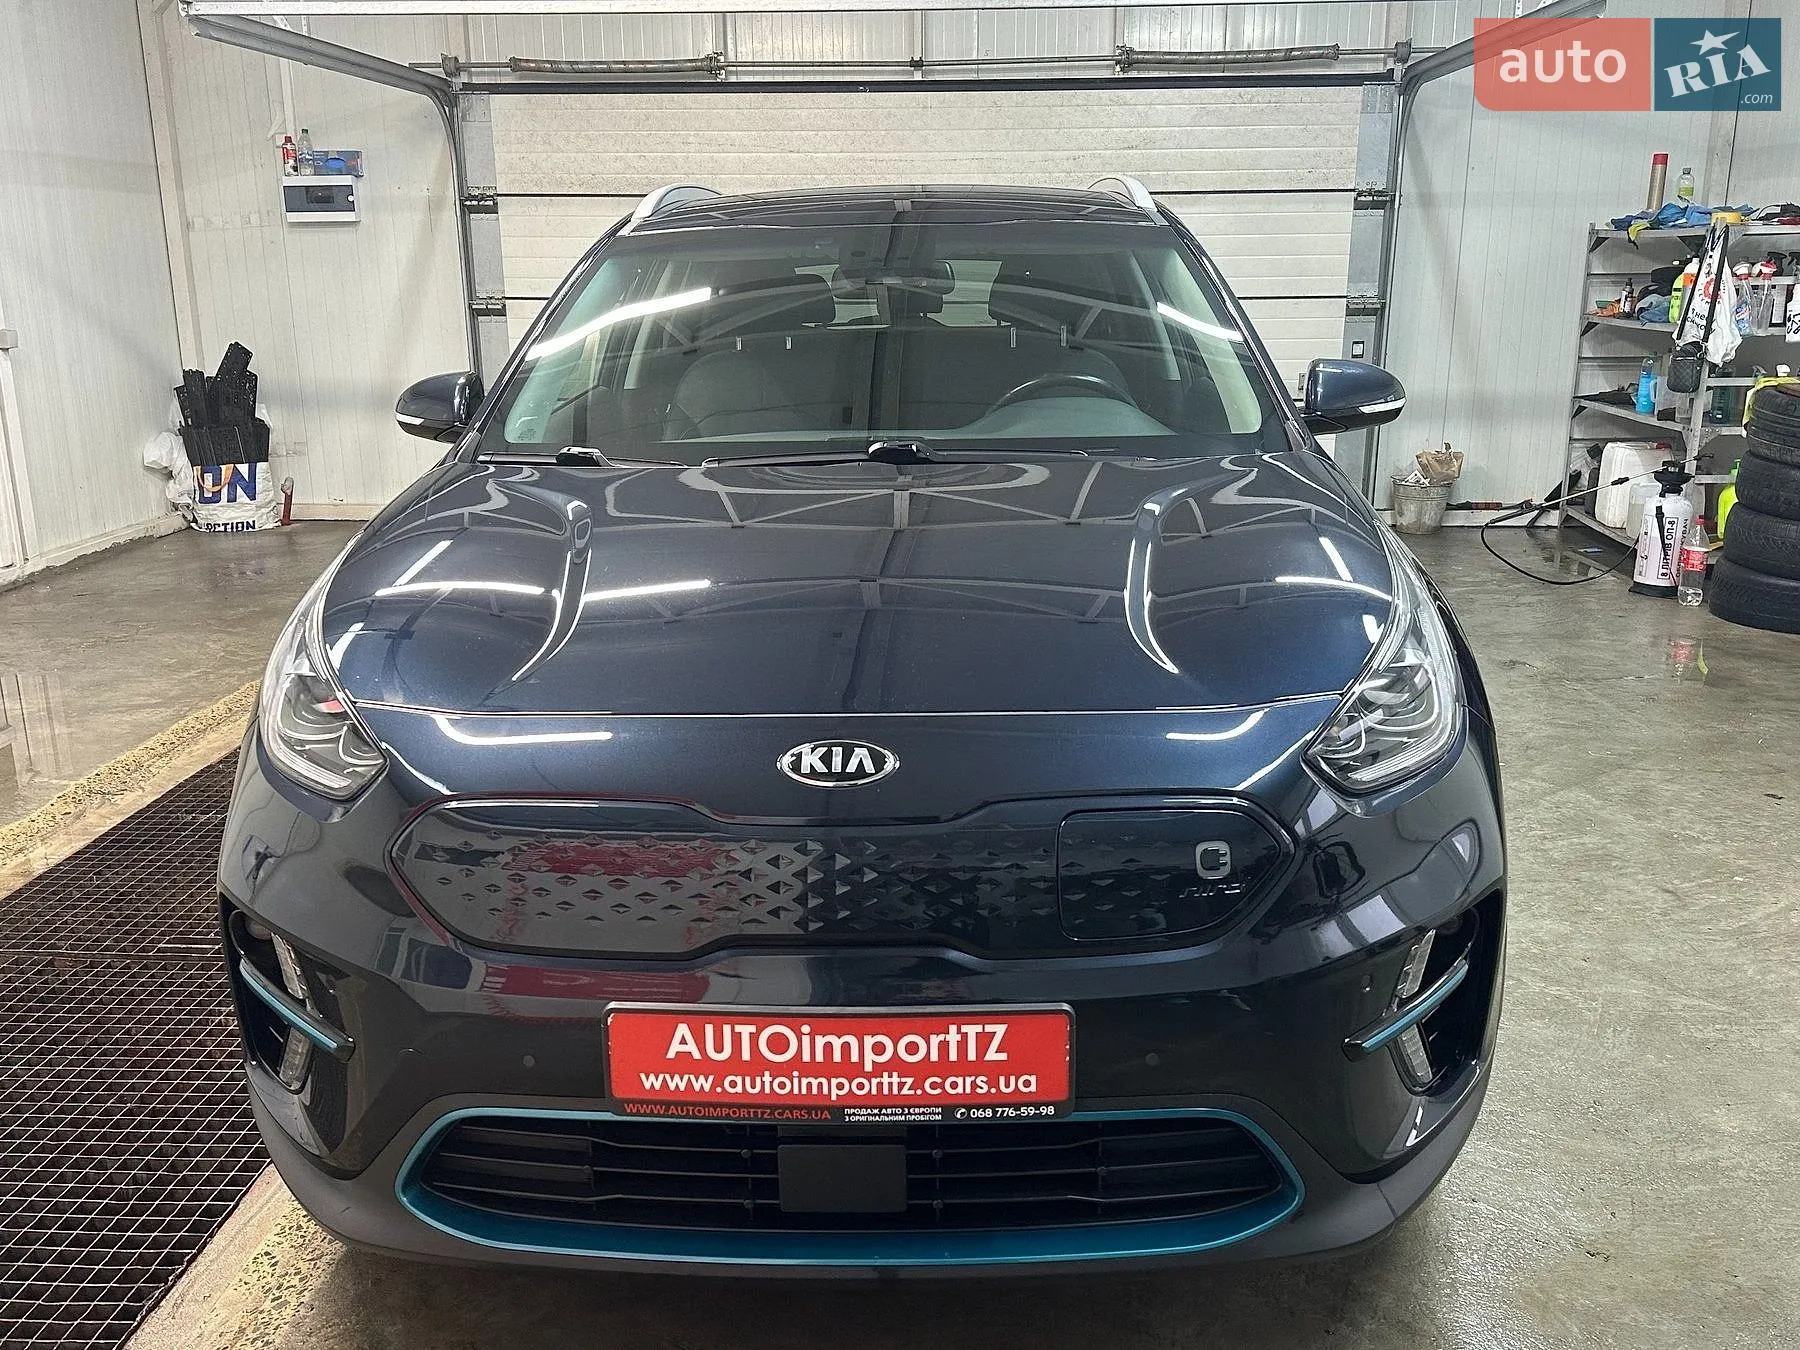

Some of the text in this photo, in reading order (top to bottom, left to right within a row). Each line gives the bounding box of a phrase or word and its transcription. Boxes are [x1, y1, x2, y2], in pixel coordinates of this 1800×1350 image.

[800, 746, 876, 774] KIA
[666, 1022, 1008, 1072] AUTOimportTZ
[640, 1070, 1037, 1101] www.autoimporttz.cars.ua
[624, 1103, 831, 1120] WWW.AUTOIMPORTTZ.CARS.UA
[970, 1105, 1055, 1118] 068 776-59-98
